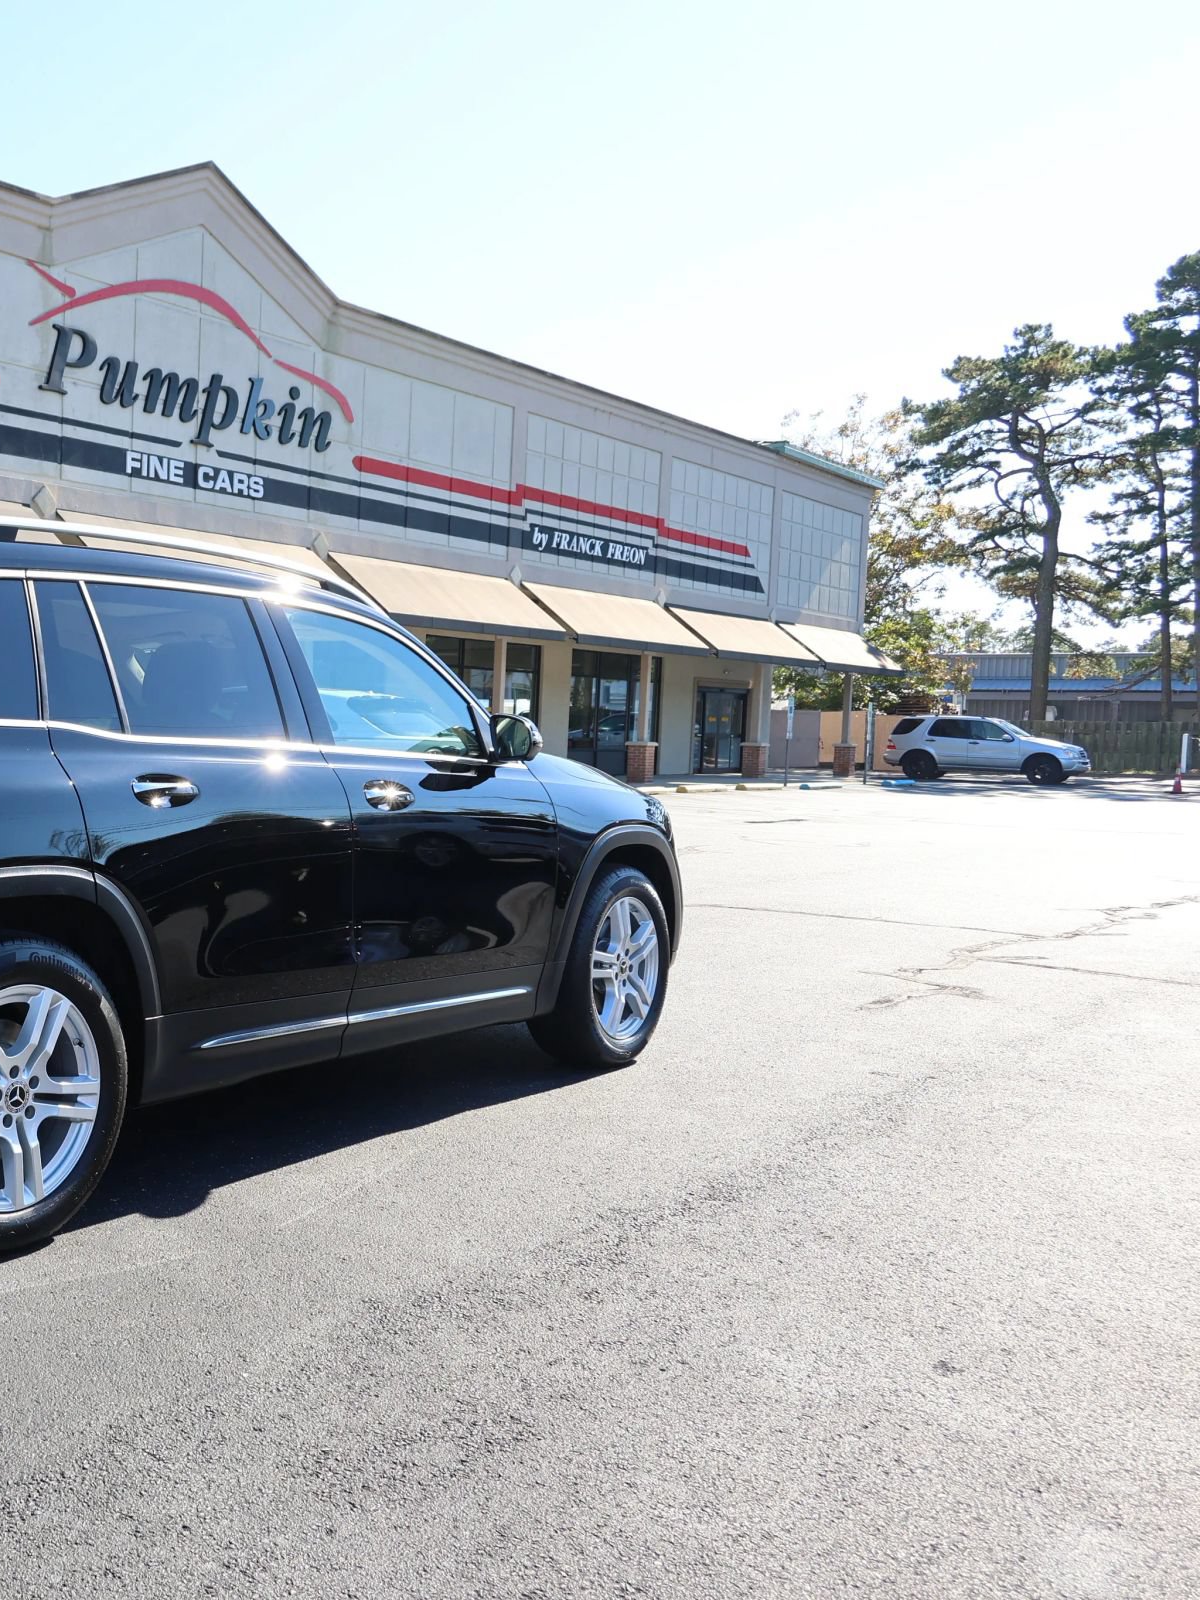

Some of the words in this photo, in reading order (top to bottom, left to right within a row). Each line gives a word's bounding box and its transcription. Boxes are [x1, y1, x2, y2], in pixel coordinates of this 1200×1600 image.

[38, 323, 333, 453] Pumpkin
[124, 450, 185, 484] FINE
[197, 465, 265, 499] CARS
[532, 526, 549, 551] by
[551, 531, 605, 557] FRANCK
[606, 542, 647, 566] FREON
[29, 951, 89, 985] Continental
